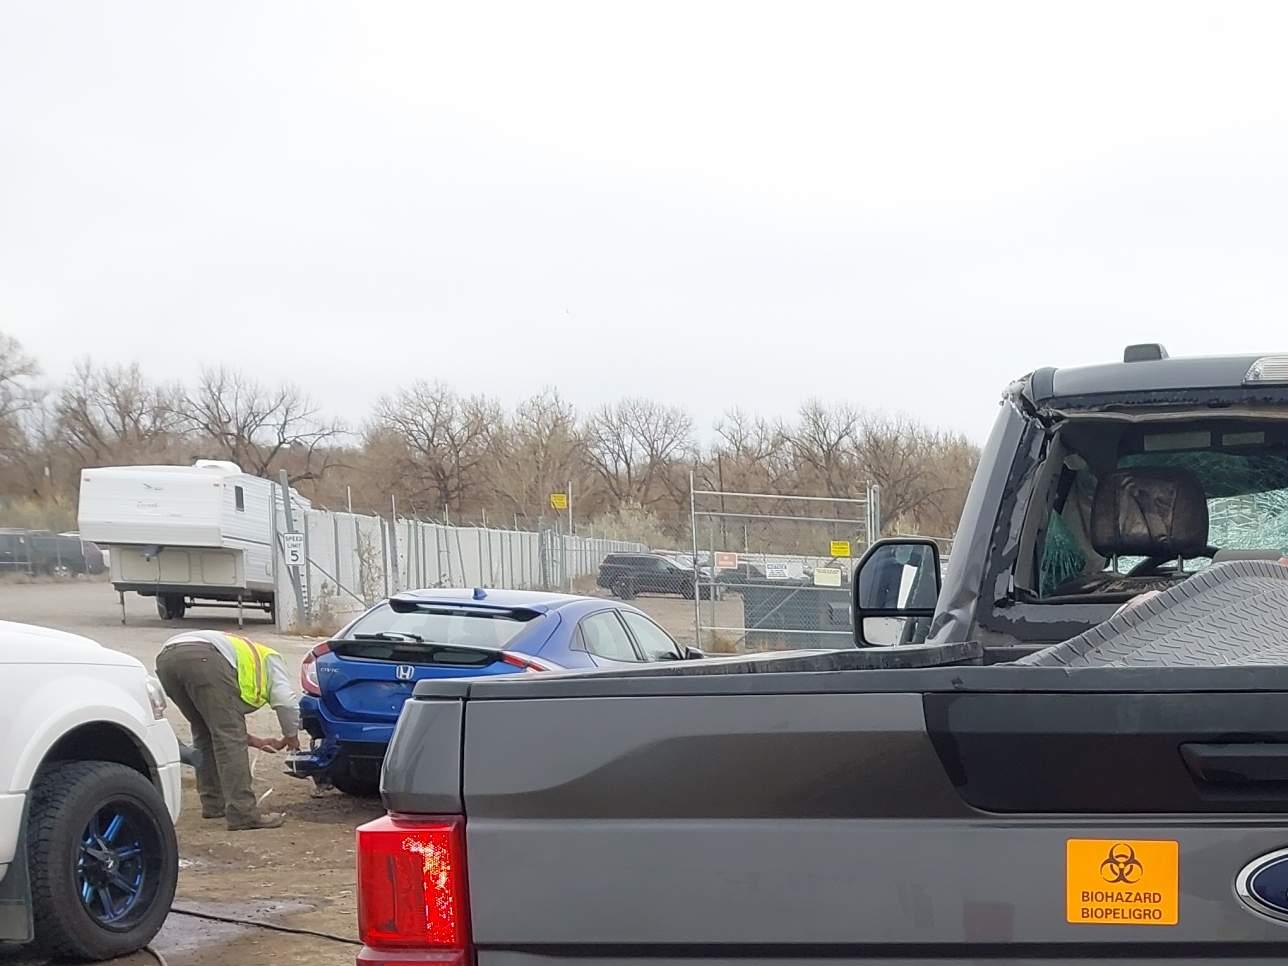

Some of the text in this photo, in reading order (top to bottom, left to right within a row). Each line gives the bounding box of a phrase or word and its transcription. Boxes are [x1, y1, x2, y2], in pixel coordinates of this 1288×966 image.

[291, 550, 299, 561] 5
[1081, 891, 1162, 903] BIOHAZARD
[1081, 907, 1162, 919] BIOPELIGRO
